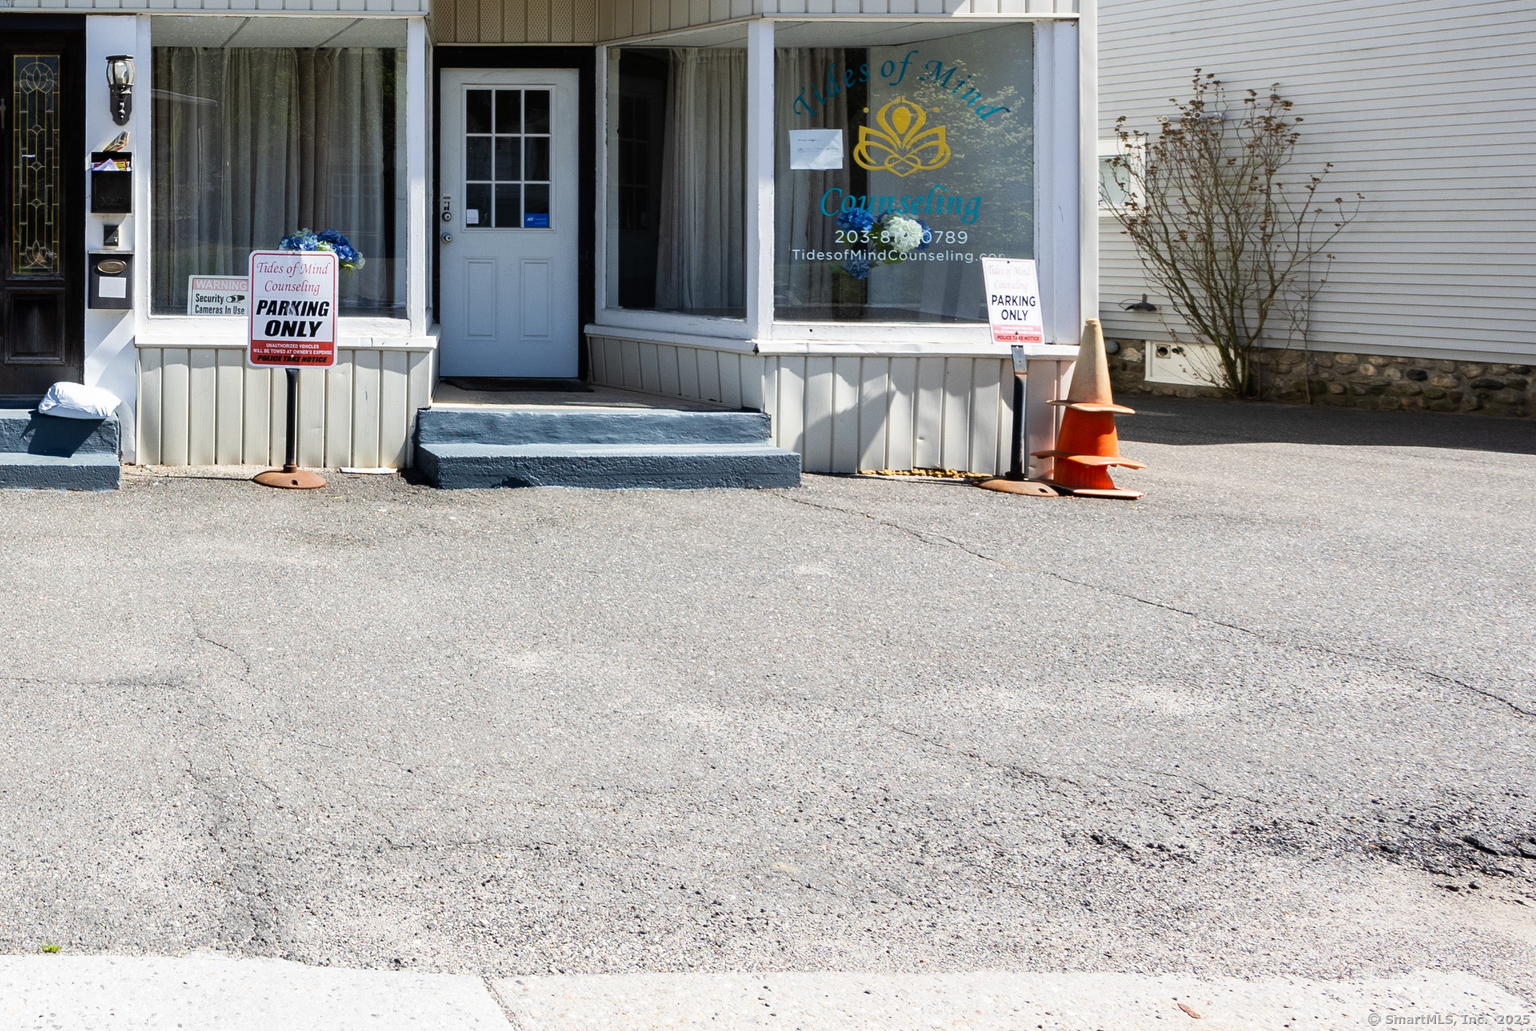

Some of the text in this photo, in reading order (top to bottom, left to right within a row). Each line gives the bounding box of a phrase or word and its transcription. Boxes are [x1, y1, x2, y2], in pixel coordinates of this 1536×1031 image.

[792, 50, 1011, 120] Tides of Mind
[819, 184, 983, 225] Counseling
[834, 230, 968, 244] 203-8190789
[256, 261, 331, 278] Tides of Mind
[195, 280, 248, 291] WARNING
[264, 279, 321, 296] Counseling
[195, 293, 225, 305] Security
[991, 294, 1036, 307] PARKING
[194, 304, 246, 315] Cameras In Use
[255, 299, 330, 317] PARKING
[1001, 309, 1029, 321] ONLY
[264, 319, 323, 338] ONLY
